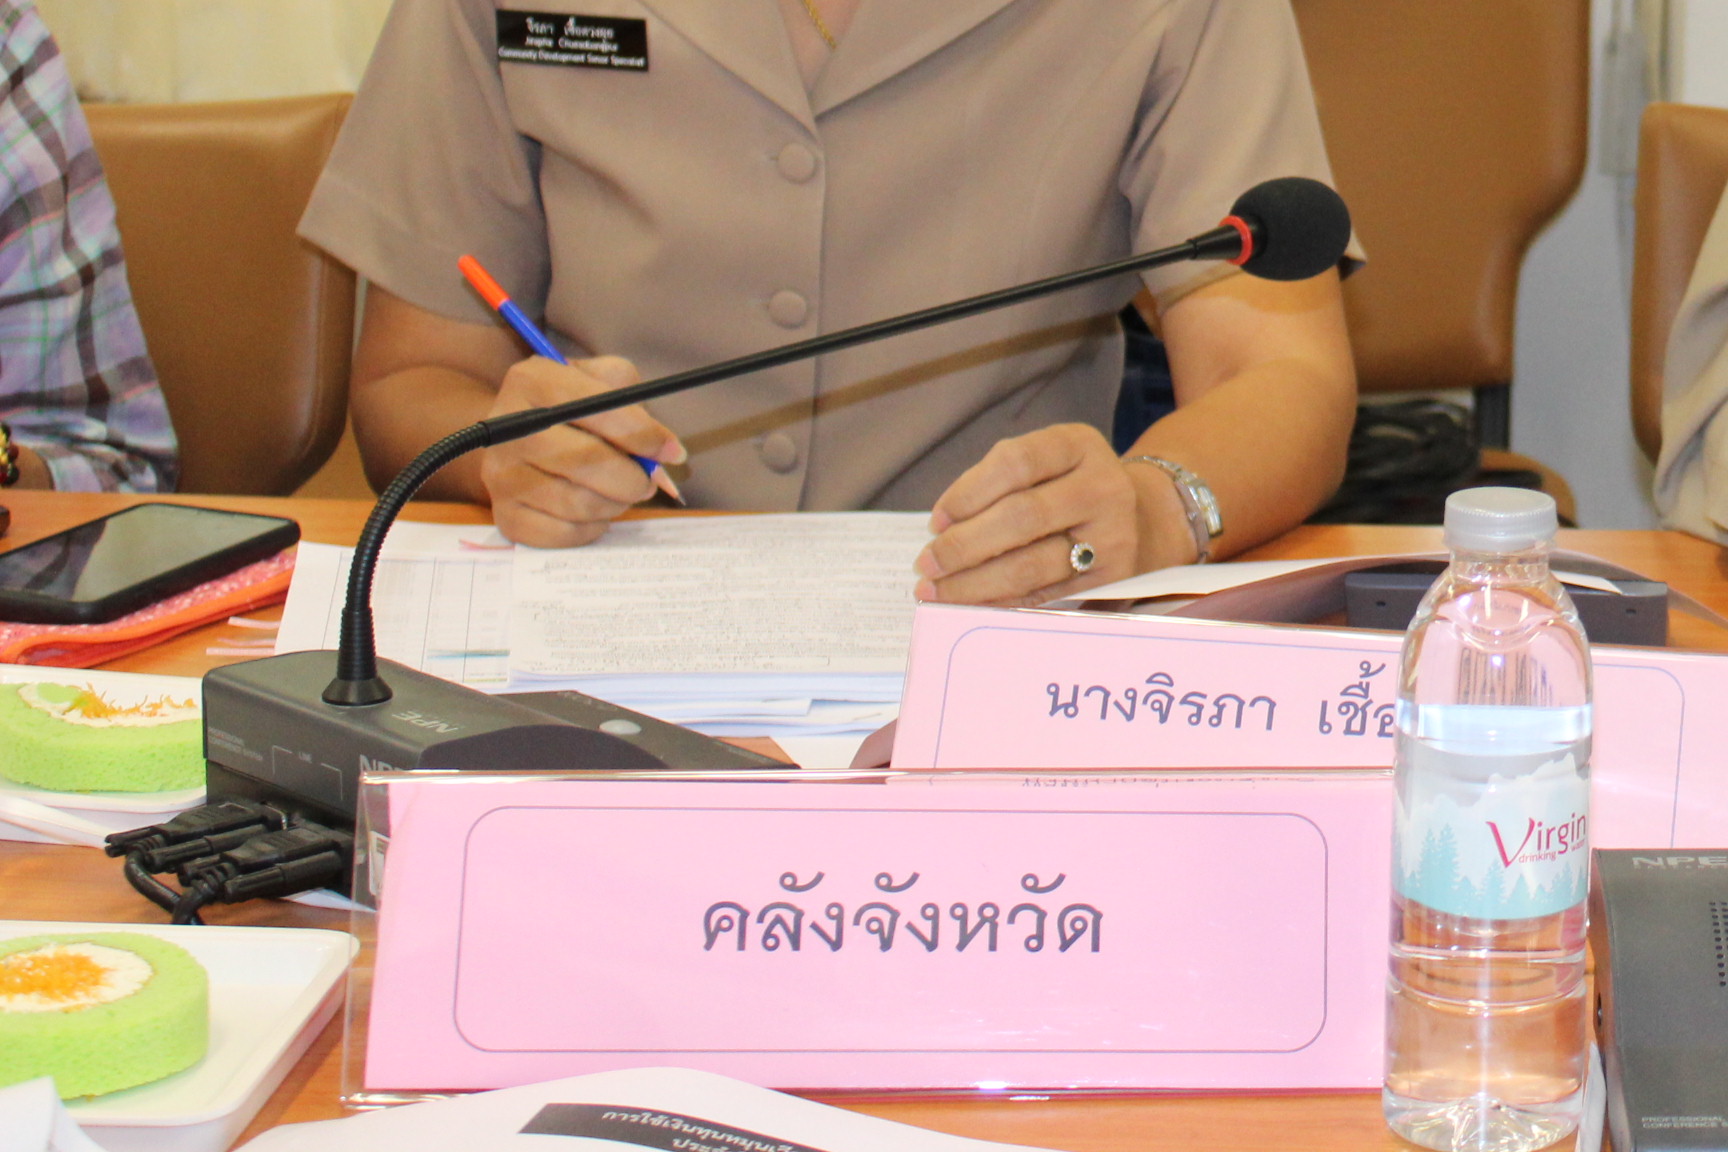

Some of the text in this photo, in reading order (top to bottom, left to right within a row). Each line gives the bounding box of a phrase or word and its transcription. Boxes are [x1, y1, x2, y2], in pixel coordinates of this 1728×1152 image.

[1046, 659, 1397, 739] นางจิรภา เชื้อ
[1484, 812, 1587, 868] Virgin
[1518, 850, 1557, 864] drinking
[703, 871, 1104, 953] คลังจังหวัด
